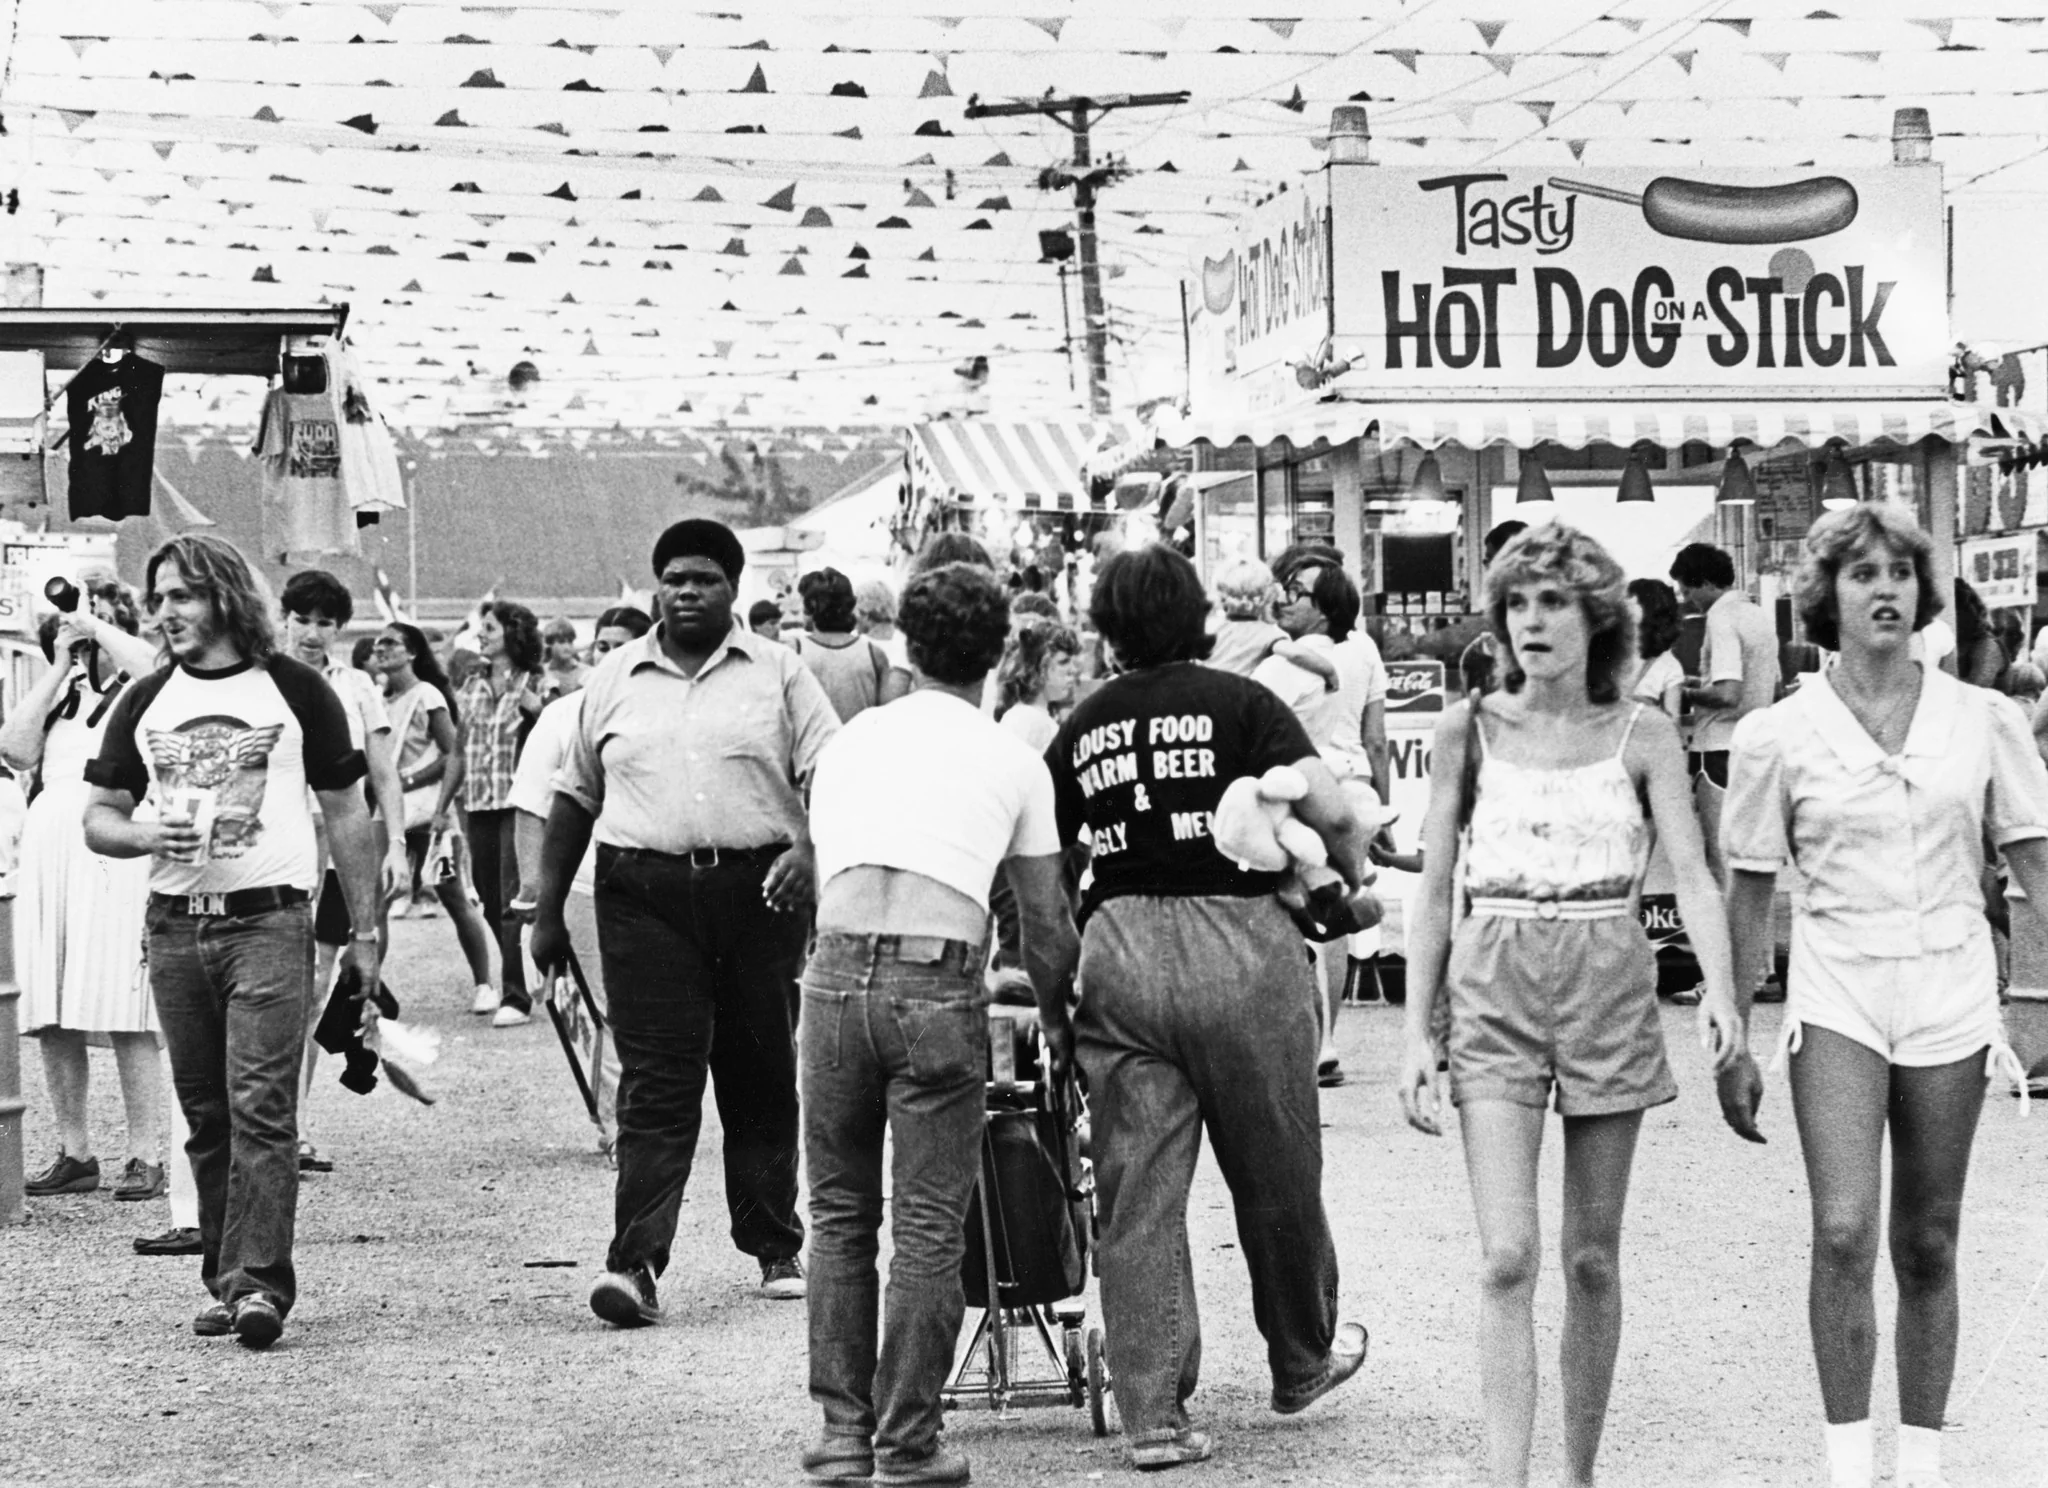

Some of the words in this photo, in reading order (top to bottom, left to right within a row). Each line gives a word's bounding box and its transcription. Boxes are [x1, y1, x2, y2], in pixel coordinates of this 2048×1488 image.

[1417, 173, 1577, 255] Tasty
[1654, 300, 1685, 321] ON
[1692, 300, 1708, 321] A
[1073, 718, 1137, 768] LOUSY
[1149, 715, 1213, 745] FOOD
[1077, 752, 1138, 798] WARM
[1153, 749, 1216, 779] BEER
[1134, 783, 1151, 811] &
[188, 893, 226, 916] RON
